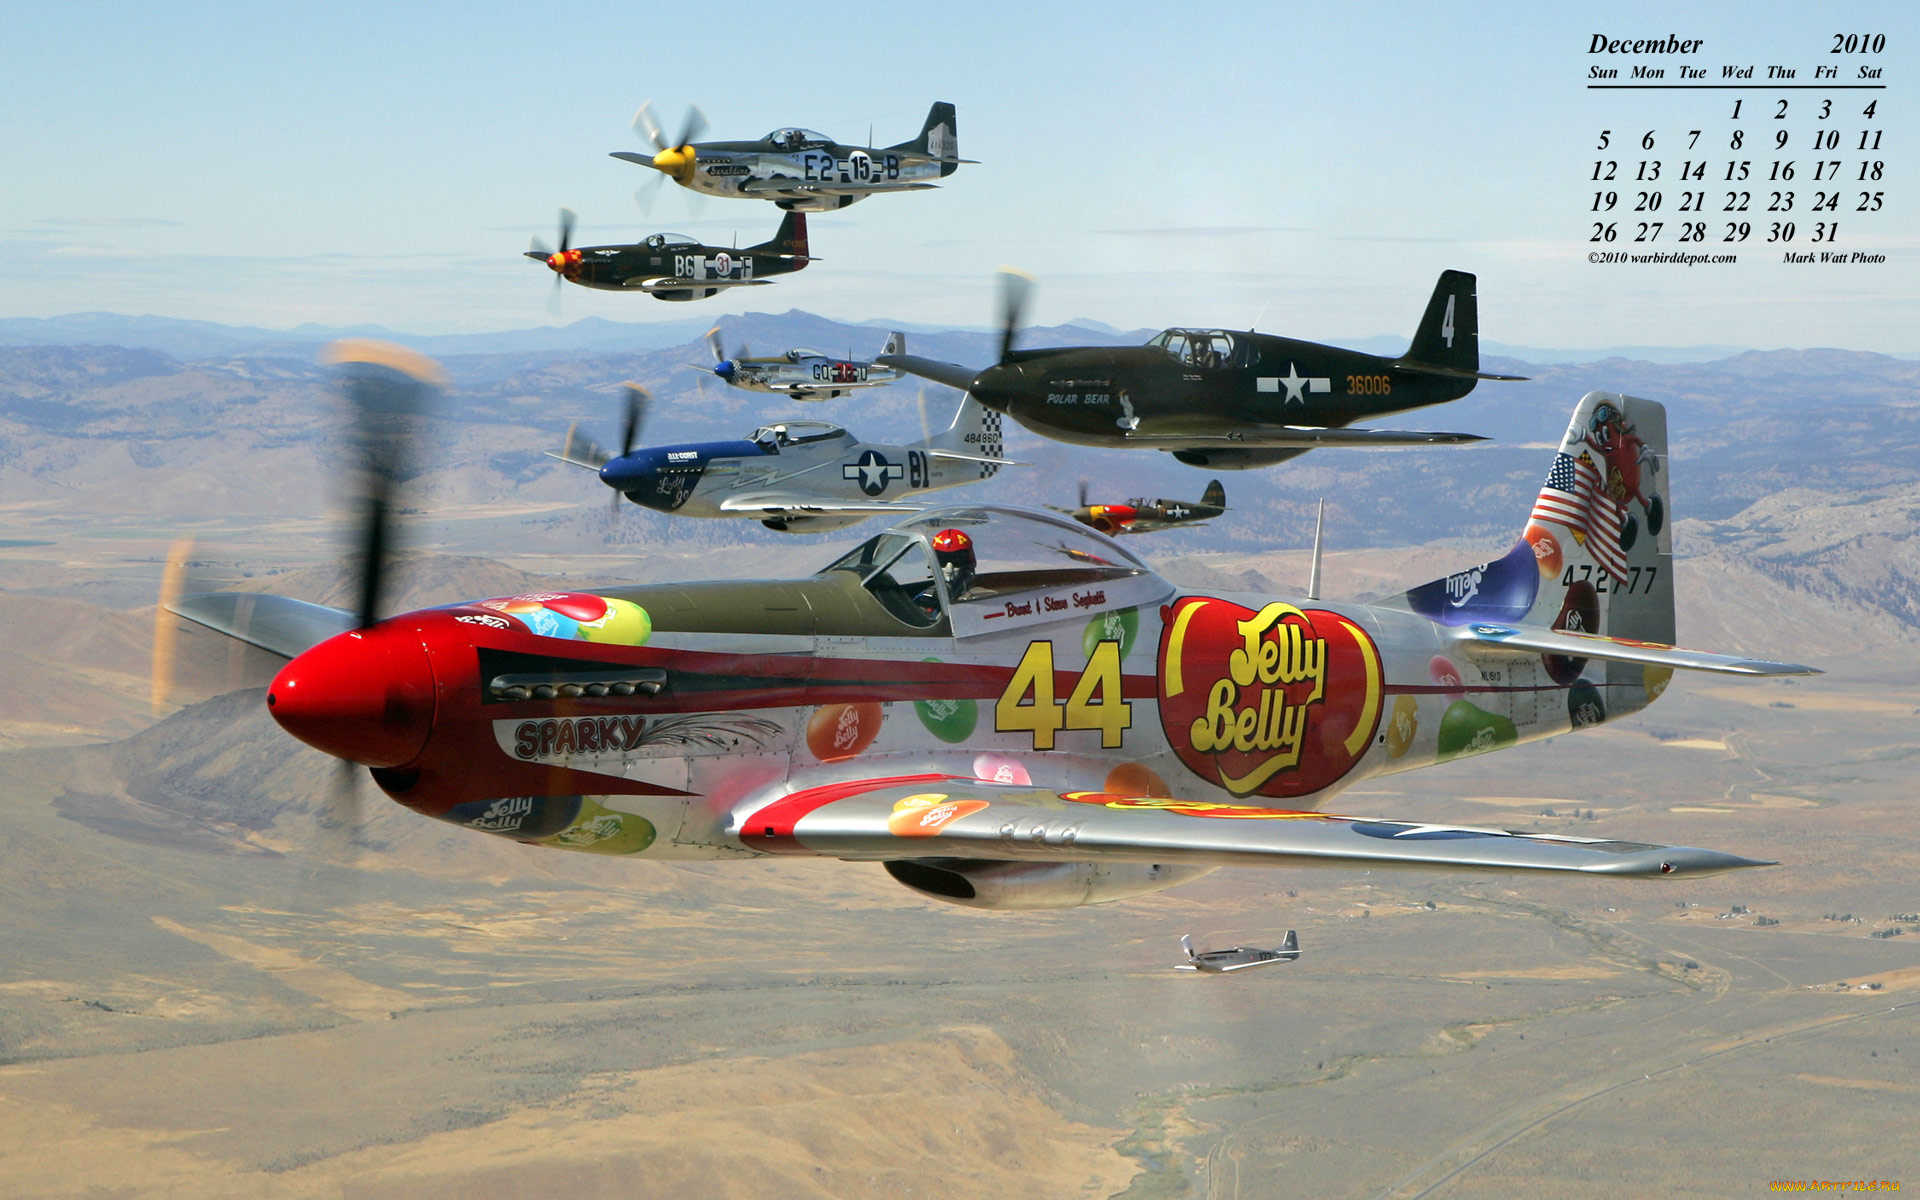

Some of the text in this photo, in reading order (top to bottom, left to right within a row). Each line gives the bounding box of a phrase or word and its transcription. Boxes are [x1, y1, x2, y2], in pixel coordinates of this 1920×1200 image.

[804, 154, 900, 182] E2 15 B
[674, 255, 695, 277] B6
[716, 256, 730, 273] 31
[1441, 294, 1456, 348] 4
[1346, 375, 1391, 395] 36006
[1047, 393, 1110, 404] POLAR BEAR
[1230, 602, 1329, 705] Jelly
[995, 640, 1132, 750] 44
[515, 716, 646, 759] SPARKY
[834, 725, 859, 750] Belly
[1190, 678, 1308, 798] Belly
[484, 797, 533, 818] Jelly
[920, 811, 953, 827] Belly
[464, 815, 523, 832] Belly
